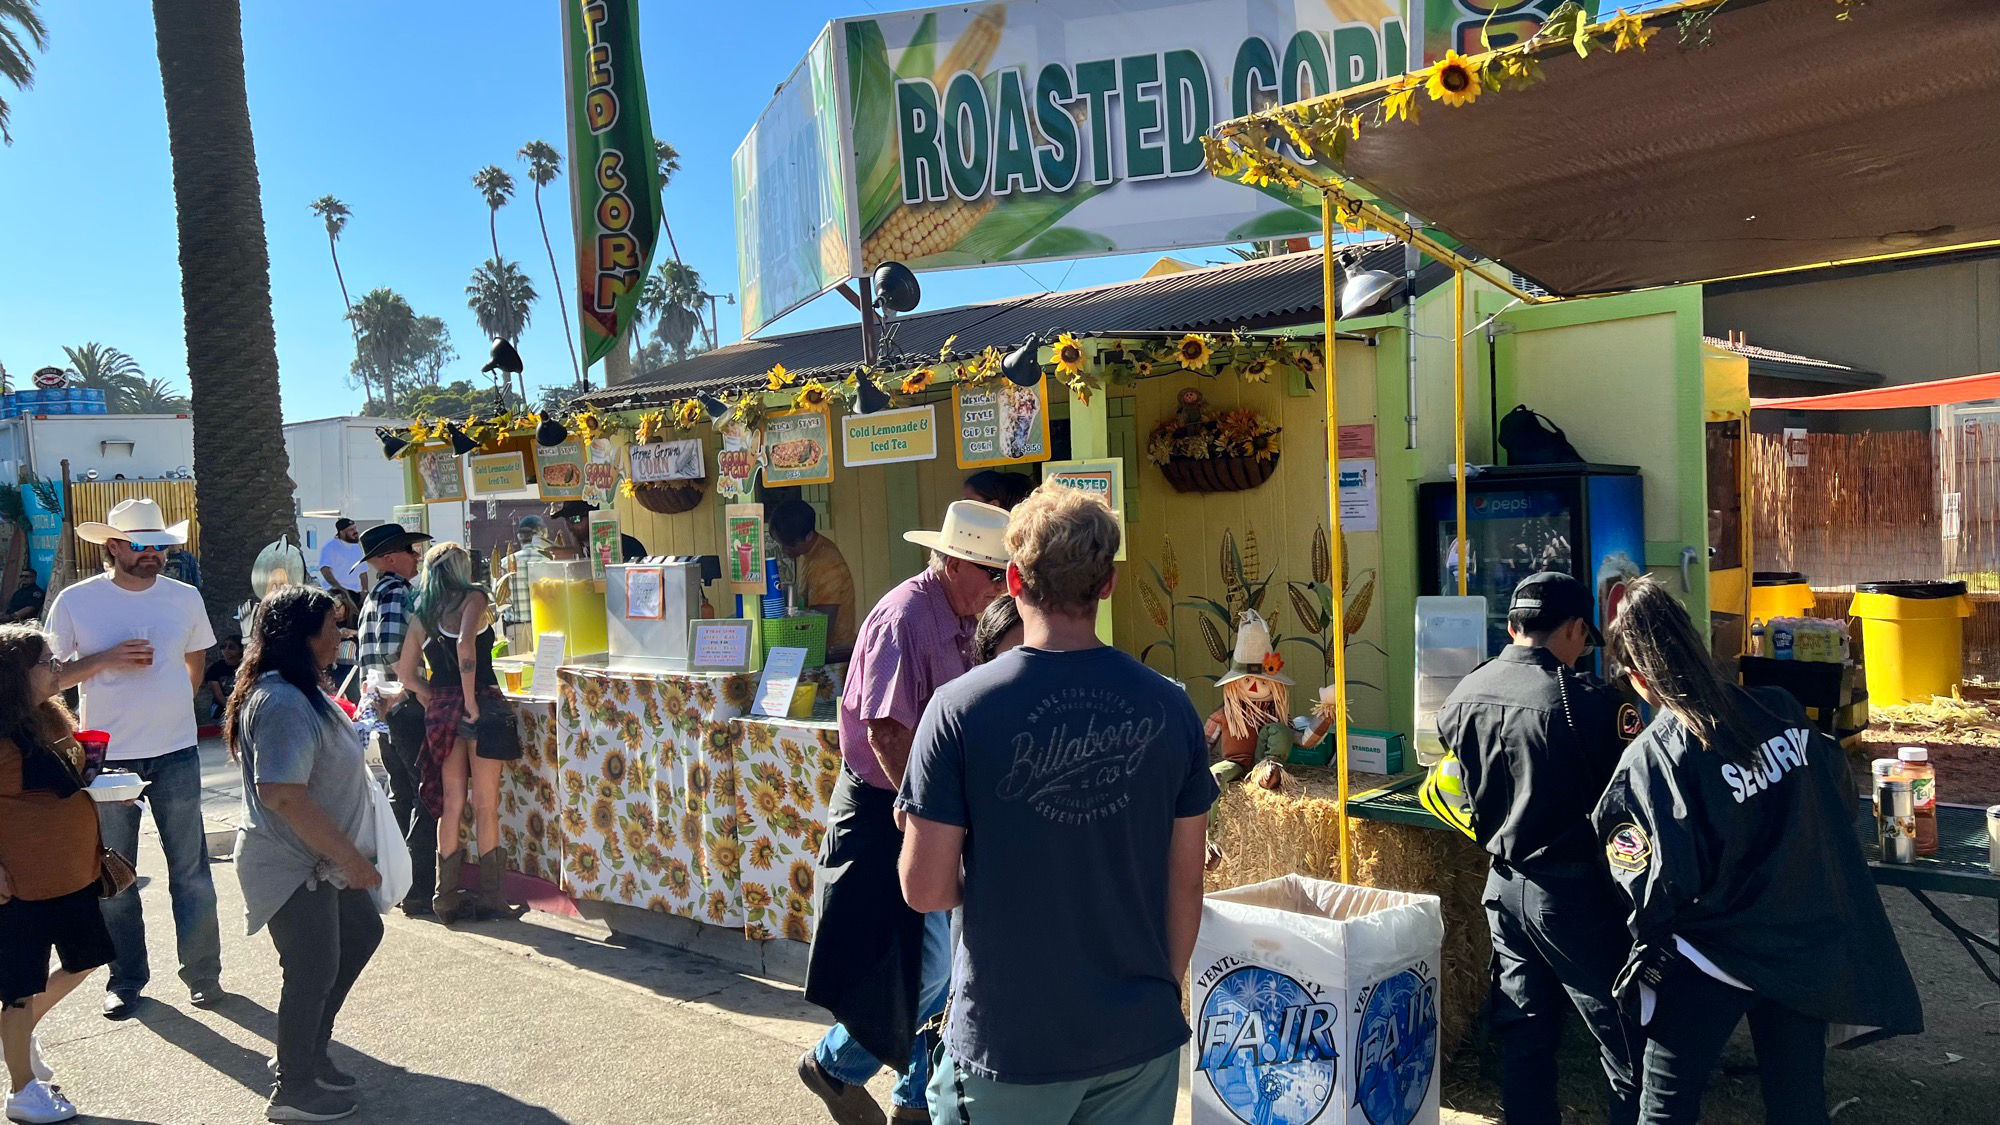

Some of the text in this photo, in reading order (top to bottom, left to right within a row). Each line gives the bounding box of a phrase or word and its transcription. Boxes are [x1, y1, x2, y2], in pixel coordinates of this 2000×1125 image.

[895, 49, 1212, 204] ROASTED
[595, 149, 642, 312] CORN
[961, 393, 996, 405] MEXICAN
[965, 410, 993, 421] STYLE
[849, 418, 928, 438] Cold Lemonade &
[963, 427, 997, 438] CUP OF
[632, 445, 680, 460] Home Grown
[870, 439, 907, 451] Iced Tea
[970, 442, 992, 452] CORN
[640, 458, 670, 475] CORN
[719, 452, 748, 466] CORN
[585, 463, 611, 476] CORN
[731, 465, 751, 478] CUP
[596, 476, 613, 489] CUP
[1491, 496, 1532, 513] pepsi
[1027, 688, 1135, 723] MADE FOR LIVING
[996, 700, 1166, 799] Billabong
[1351, 745, 1381, 754] STANDARD
[1035, 792, 1131, 825] SEVENTYTHREE
[1195, 1002, 1340, 1072] FAIR
[1351, 976, 1439, 1109] FAIR
